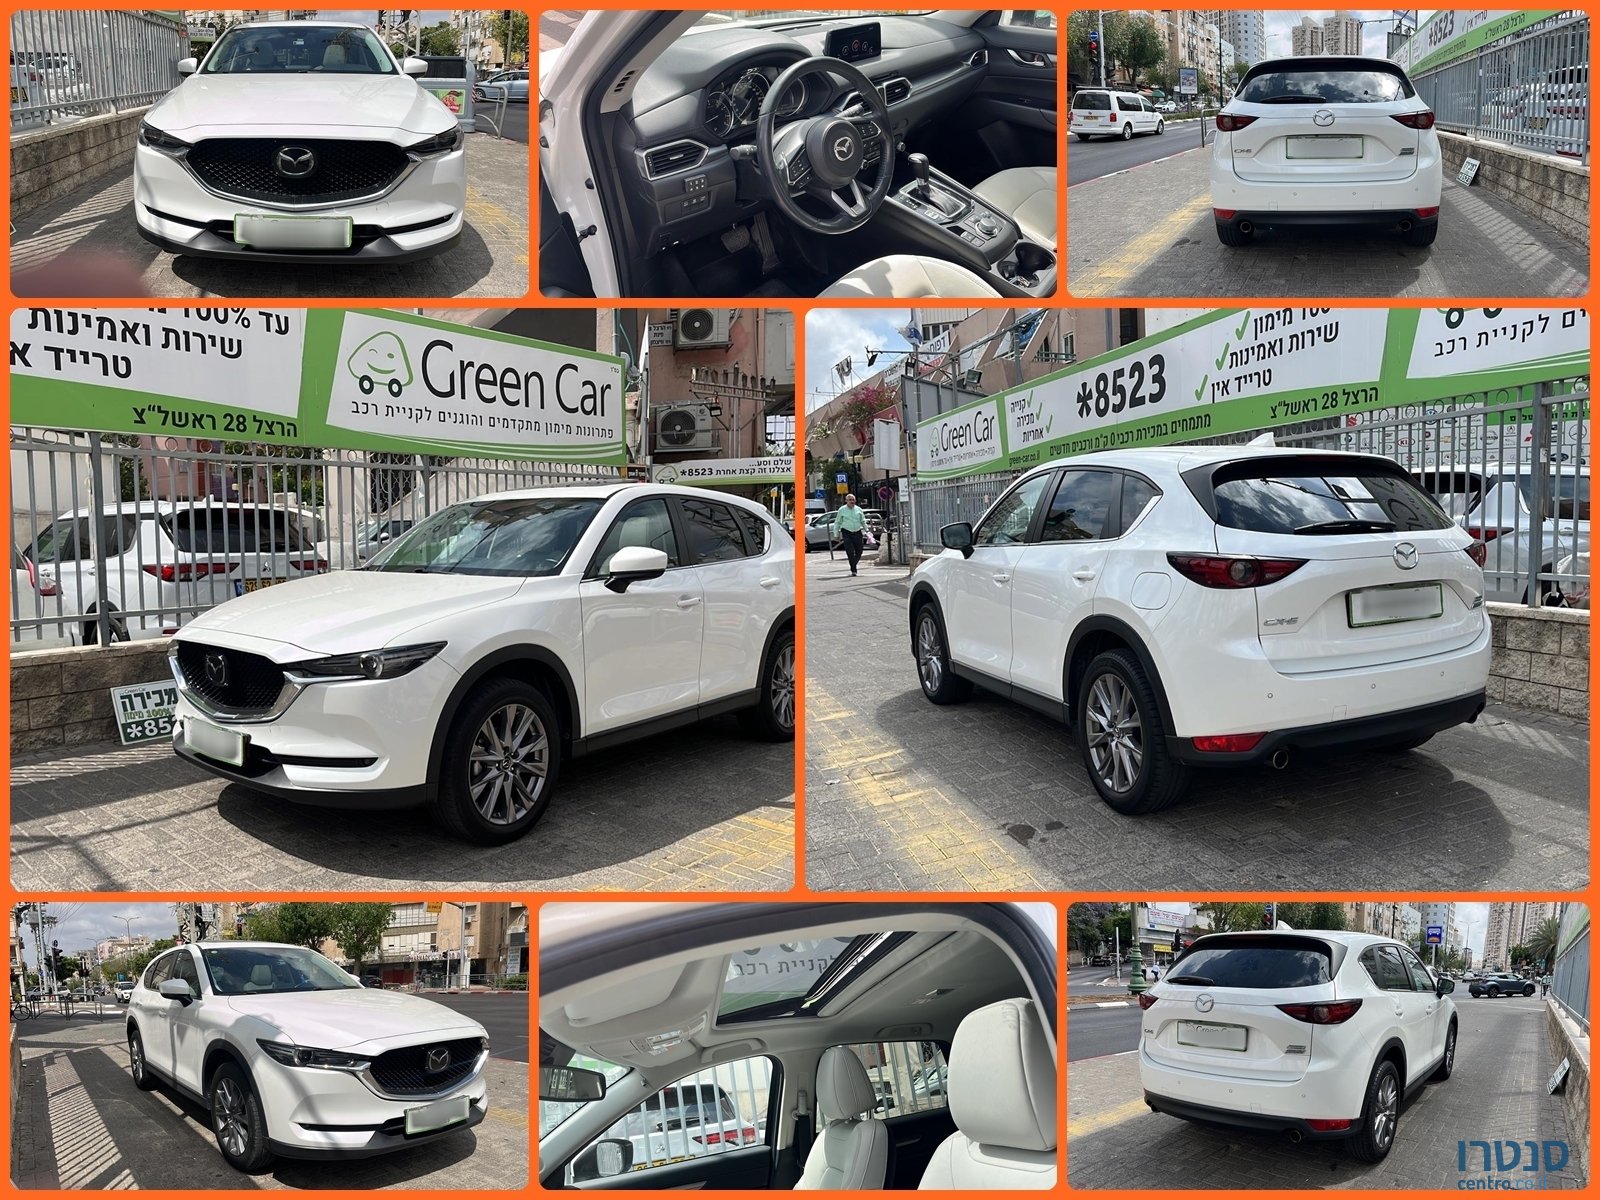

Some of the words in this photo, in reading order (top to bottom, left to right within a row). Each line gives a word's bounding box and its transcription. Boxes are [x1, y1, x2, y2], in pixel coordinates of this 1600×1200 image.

[27, 308, 151, 346] ואמינות
[258, 310, 289, 336] עד
[1253, 308, 1293, 341] מימון
[1476, 313, 1550, 343] לקניית
[161, 326, 242, 359] שירות
[1288, 321, 1339, 353] שירות
[1434, 336, 1467, 357] רכב
[43, 345, 132, 379] טרייד
[1229, 338, 1283, 369] ואמינות
[421, 339, 545, 410] Green
[555, 363, 611, 417] Car
[1235, 368, 1272, 393] טרייד
[1211, 378, 1230, 404] אין
[1321, 391, 1338, 410] 28
[1342, 386, 1378, 406] הרצל
[351, 401, 378, 415] רכב
[385, 404, 432, 423] לקניית
[1010, 398, 1026, 413] קנייה
[222, 412, 247, 433] 28
[252, 415, 298, 438] הרצל
[438, 411, 483, 427] והוגנים
[488, 416, 540, 433] מתקדמים
[545, 422, 572, 435] מימון
[1016, 412, 1035, 428] מכירה
[1171, 413, 1211, 434] מתמחים
[576, 425, 614, 439] פתרונות
[940, 422, 972, 452] Green
[974, 410, 995, 443] Car
[1022, 427, 1044, 443] אחריות
[1110, 432, 1116, 446] 0
[1117, 430, 1134, 445] רכבי
[1136, 423, 1168, 441] במכירת
[1049, 442, 1070, 456] חדשים
[1072, 438, 1093, 453] ורכבים
[120, 688, 178, 712] מכירה
